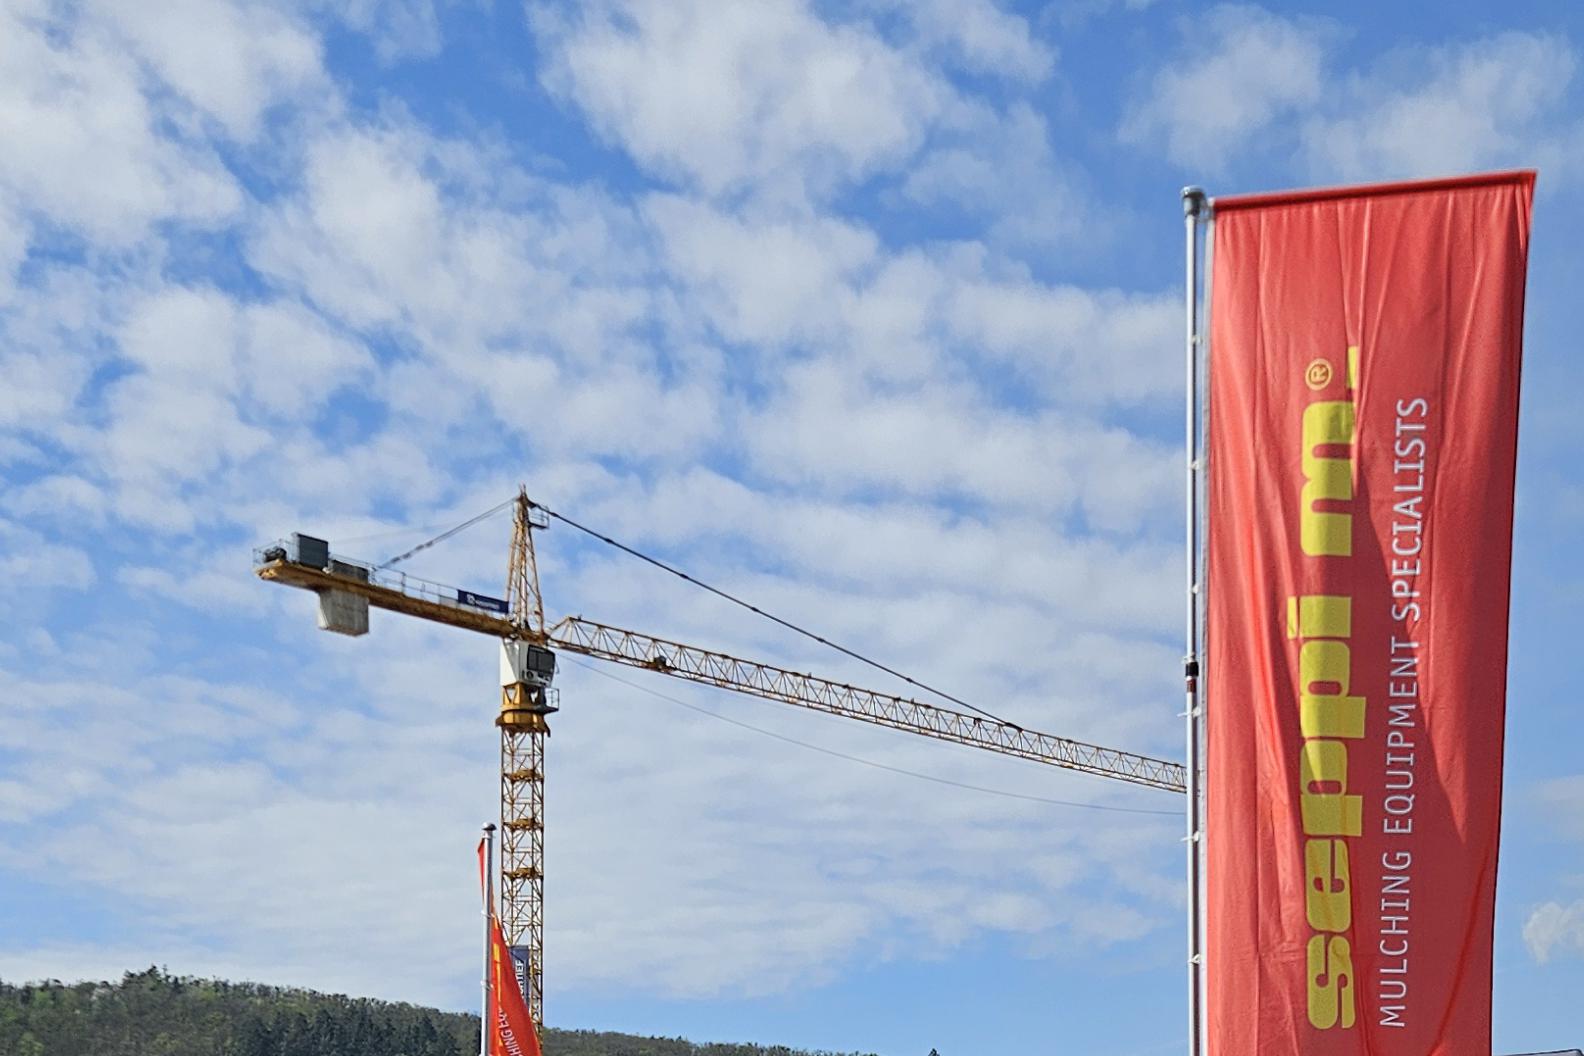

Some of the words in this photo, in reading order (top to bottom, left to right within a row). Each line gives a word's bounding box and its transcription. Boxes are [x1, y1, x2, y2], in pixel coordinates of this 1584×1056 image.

[1392, 397, 1428, 620] SPECIALISTS
[1287, 596, 1366, 1030] seppi
[1385, 635, 1418, 834] EQUIPMENT
[1380, 850, 1412, 1029] MULCHING
